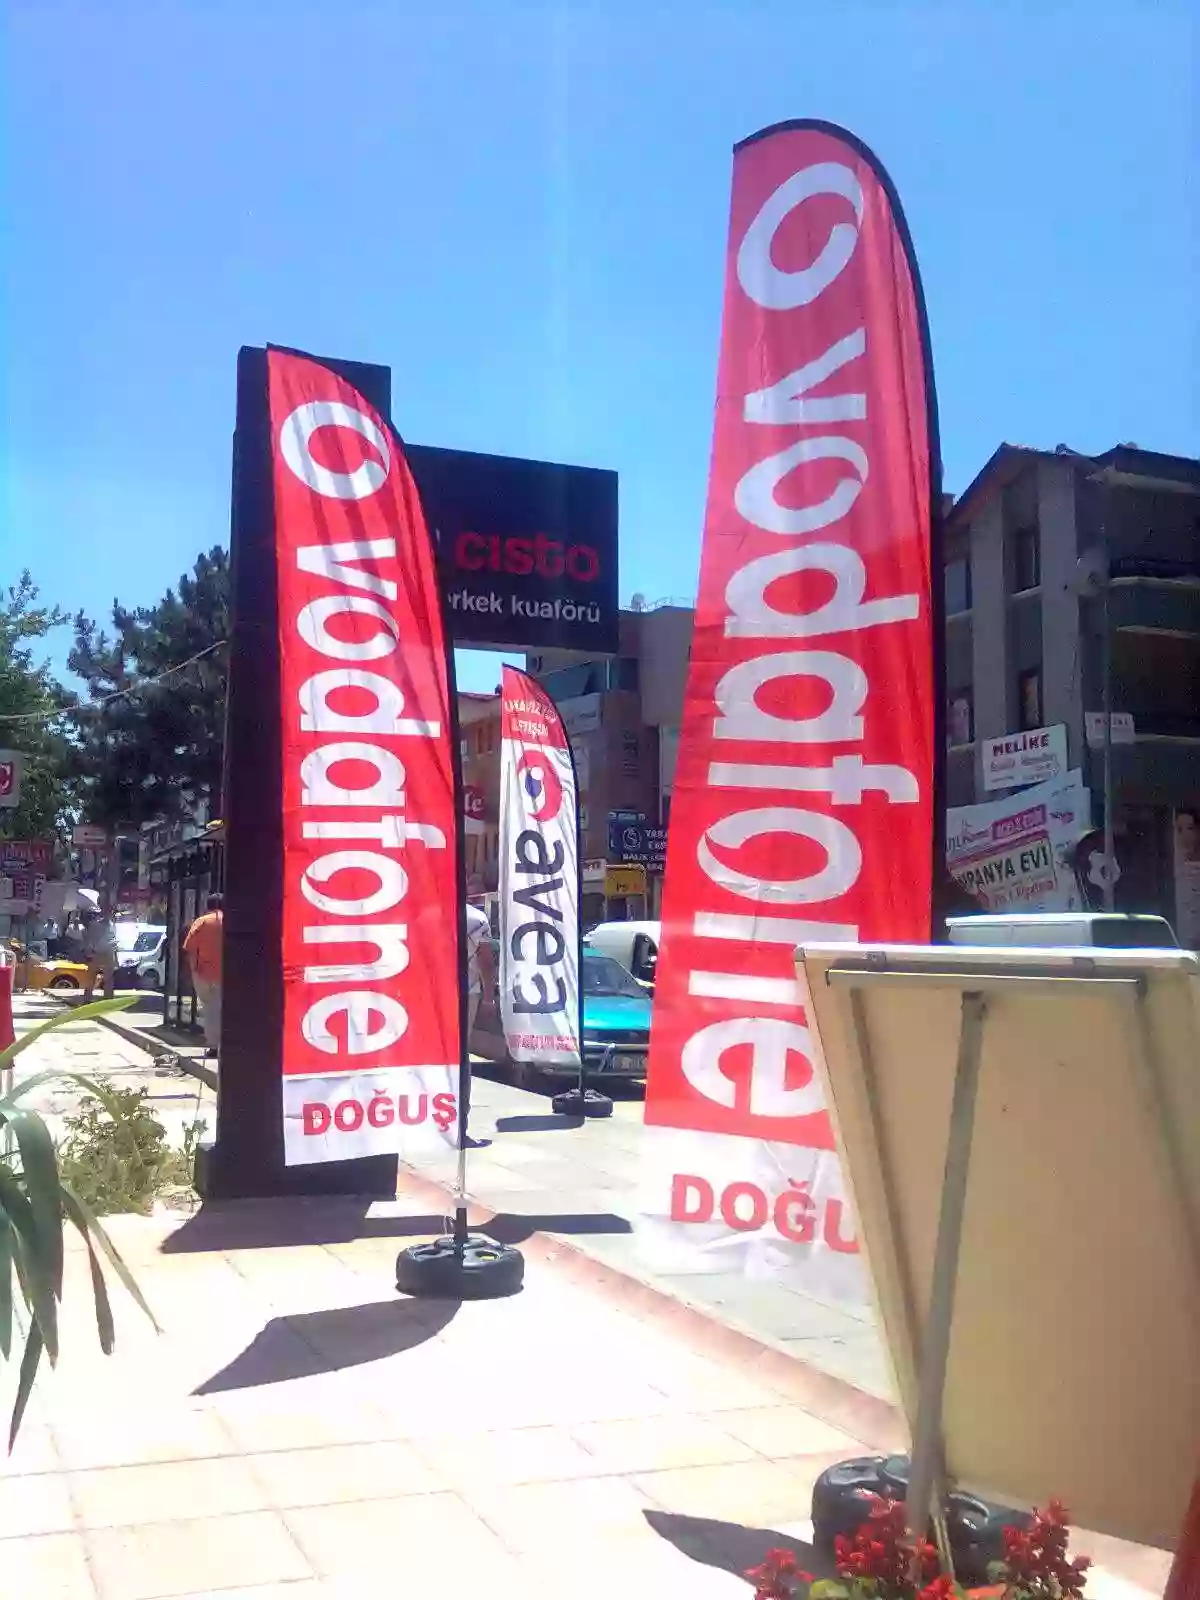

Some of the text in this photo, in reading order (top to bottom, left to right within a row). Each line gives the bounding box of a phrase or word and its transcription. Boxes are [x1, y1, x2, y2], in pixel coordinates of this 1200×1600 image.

[447, 589, 600, 624] rkek kuaförü
[296, 537, 446, 1058] vodafone
[510, 829, 567, 1014] avea
[304, 1089, 459, 1136] DOĞUŞ
